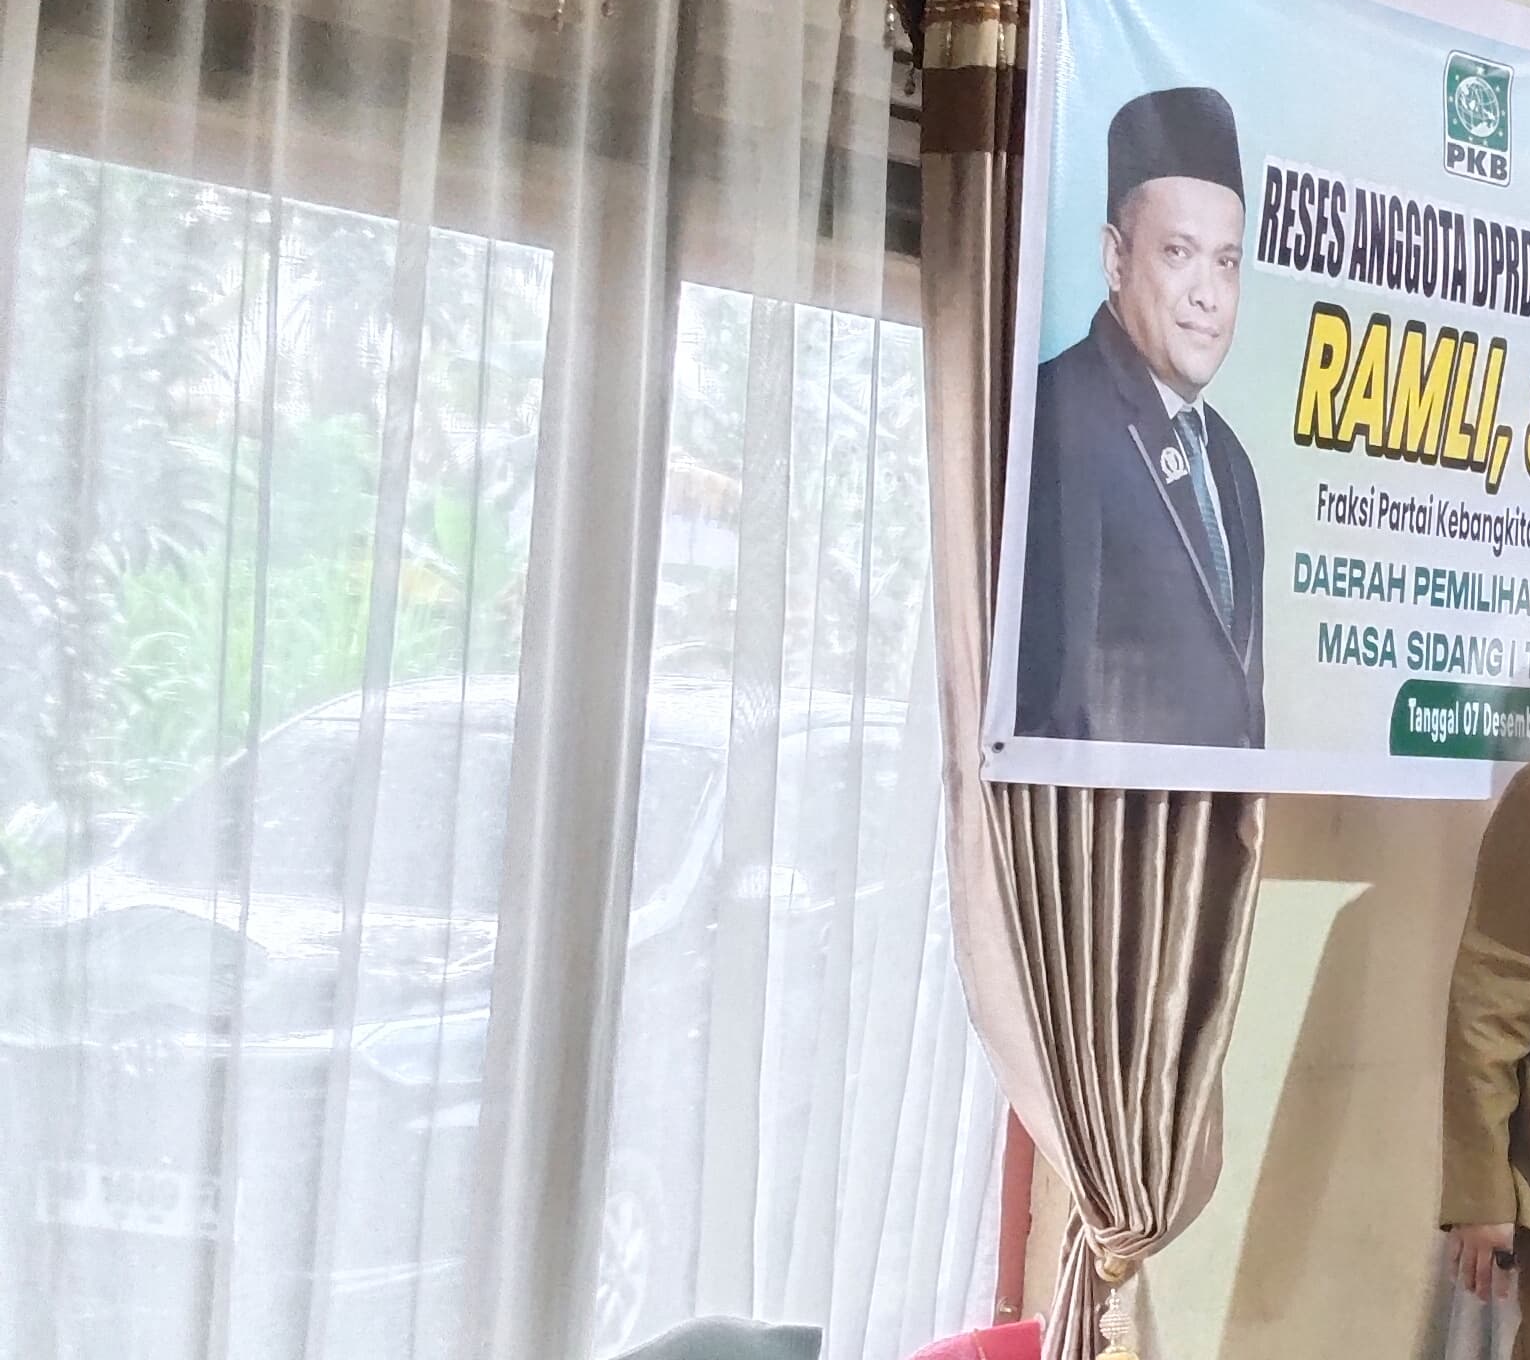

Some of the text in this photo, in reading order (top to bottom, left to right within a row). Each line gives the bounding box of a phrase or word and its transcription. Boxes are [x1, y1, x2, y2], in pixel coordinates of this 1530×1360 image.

[1446, 141, 1508, 181] PKB
[1257, 165, 1346, 277] RESES
[1348, 188, 1467, 304] ANGGOTA
[1294, 301, 1512, 495] RAMLI,
[1317, 483, 1375, 528] Fraksi
[1377, 492, 1434, 536] Partai
[1294, 552, 1406, 604] DAERAH
[1318, 622, 1398, 668] MASA
[1406, 630, 1503, 677] SIDANG
[1408, 698, 1459, 743] Tanggal
[1463, 702, 1480, 735] 07
